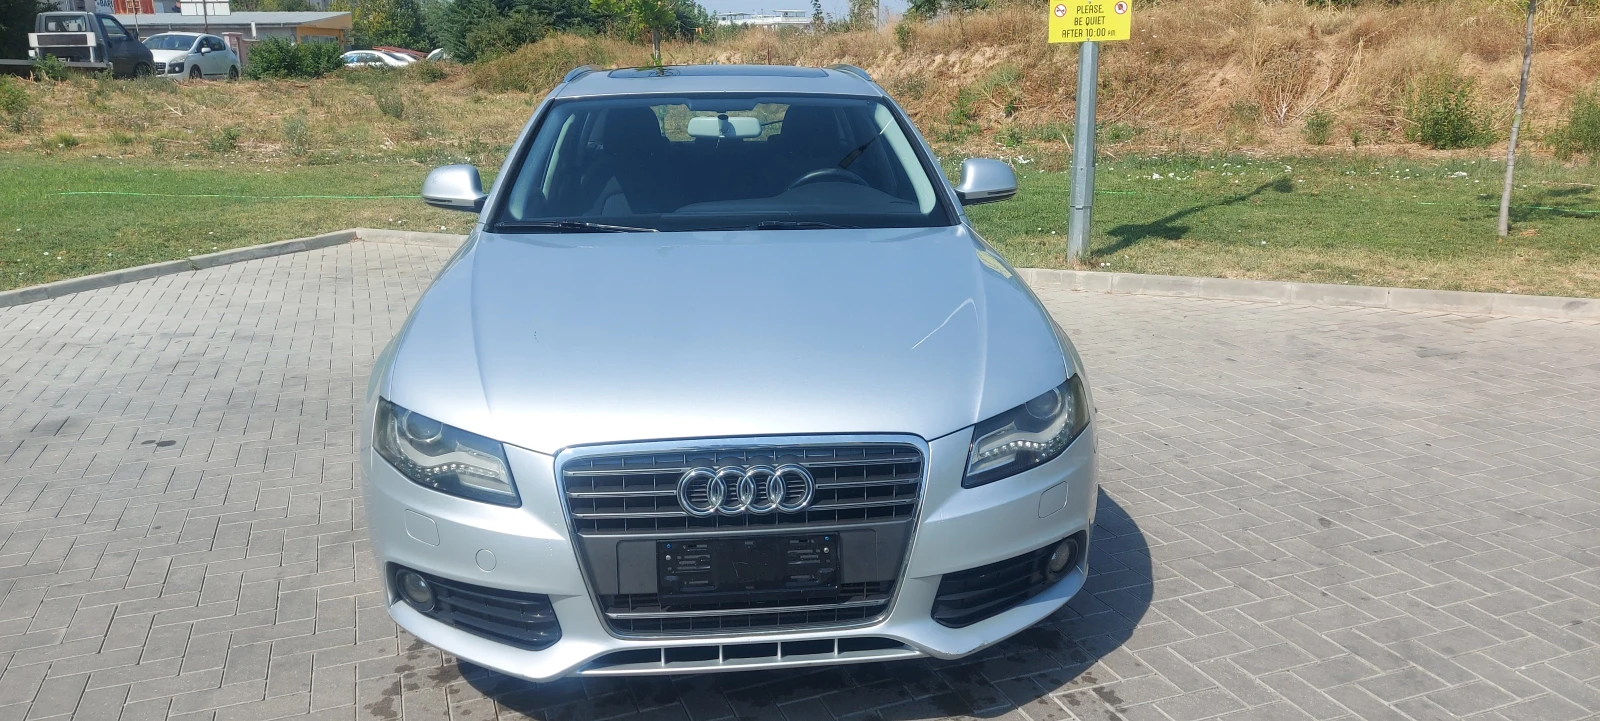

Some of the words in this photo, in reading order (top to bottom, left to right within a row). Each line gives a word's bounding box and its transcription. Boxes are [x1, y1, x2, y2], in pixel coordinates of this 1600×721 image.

[1074, 17, 1083, 25] BE
[1086, 16, 1105, 26] QUIET
[1062, 29, 1083, 38] AFTER
[1086, 28, 1106, 37] 10:00
